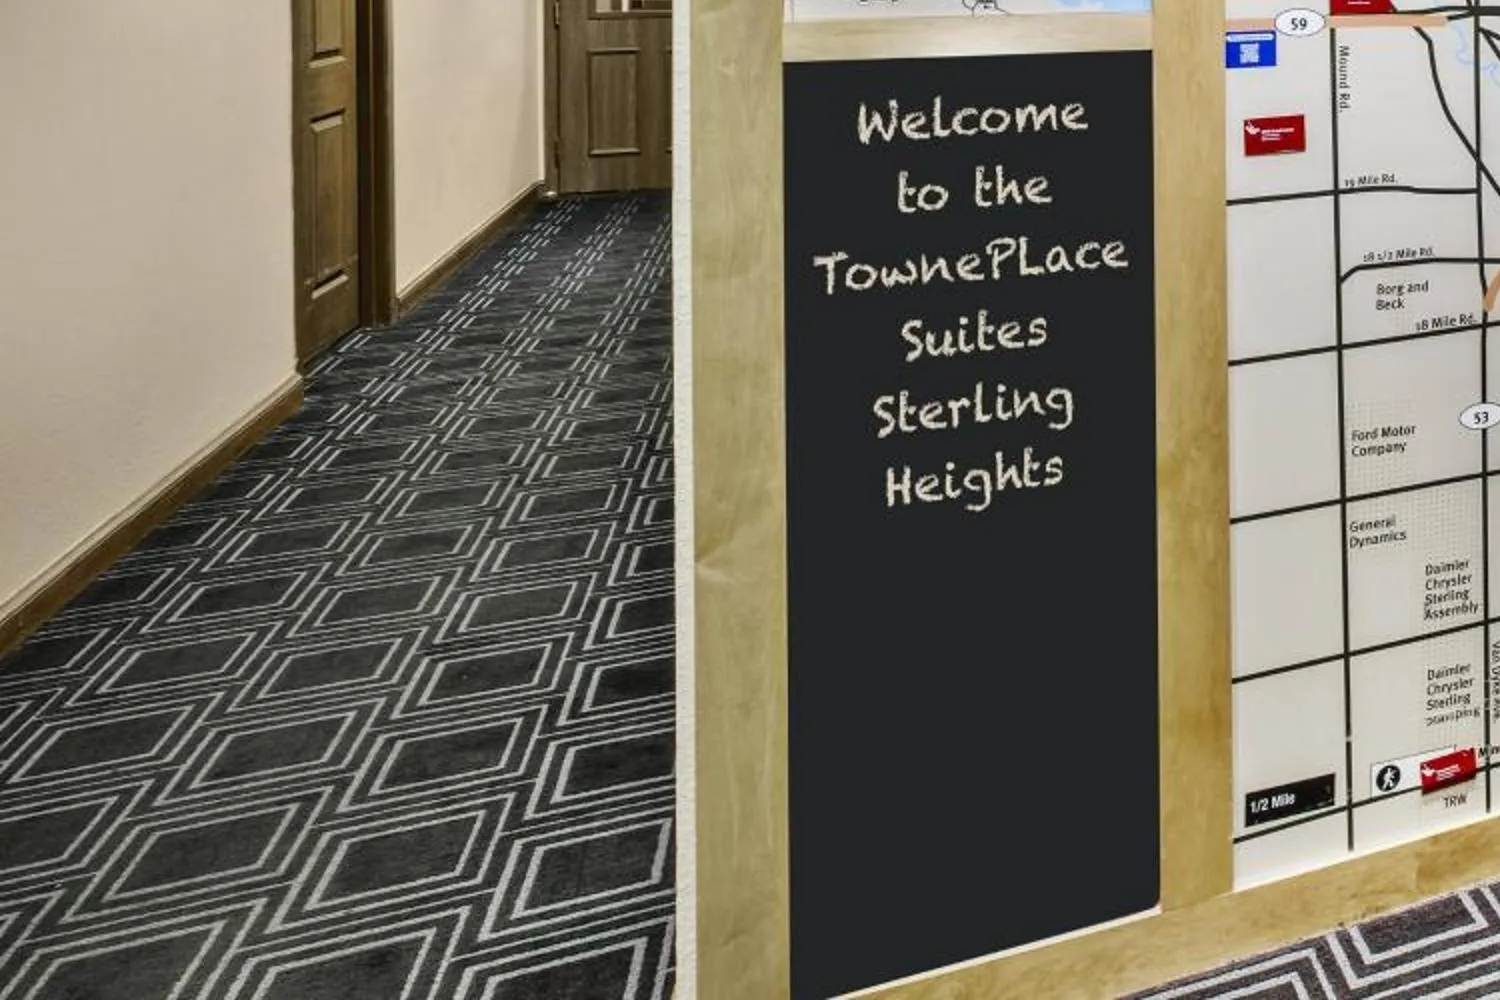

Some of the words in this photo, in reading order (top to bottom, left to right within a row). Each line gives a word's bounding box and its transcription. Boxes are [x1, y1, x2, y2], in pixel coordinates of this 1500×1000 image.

[1290, 17, 1308, 31] 59
[1339, 45, 1350, 91] Mound
[857, 96, 1089, 145] Welcome
[897, 170, 950, 213] to
[975, 165, 1053, 207] the
[1356, 173, 1380, 187] Mile
[1394, 247, 1416, 260] Mile
[1376, 283, 1405, 300] Borg
[1406, 280, 1430, 294] and
[1375, 297, 1405, 311] Beck
[1431, 315, 1456, 329] Mile
[901, 309, 1048, 362] Suites
[873, 382, 1074, 439] Sterling
[1473, 411, 1489, 424] 53
[1351, 428, 1378, 442] Ford
[1380, 423, 1416, 439] Motor
[1351, 441, 1407, 458] Company
[886, 447, 1064, 512] Heights
[1349, 516, 1396, 533] General
[1349, 529, 1407, 549] Dynamics
[1425, 558, 1470, 575] Daimler
[1425, 572, 1473, 591] Chrysler
[1425, 587, 1471, 606] Sterling
[1424, 601, 1479, 621] Assembly
[1427, 663, 1472, 681] Daimler
[1426, 678, 1475, 696] Chrysler
[1426, 693, 1471, 711] Sterling
[1250, 797, 1270, 813] 1/2
[1271, 792, 1296, 809] Mile
[1443, 795, 1468, 809] TRW
